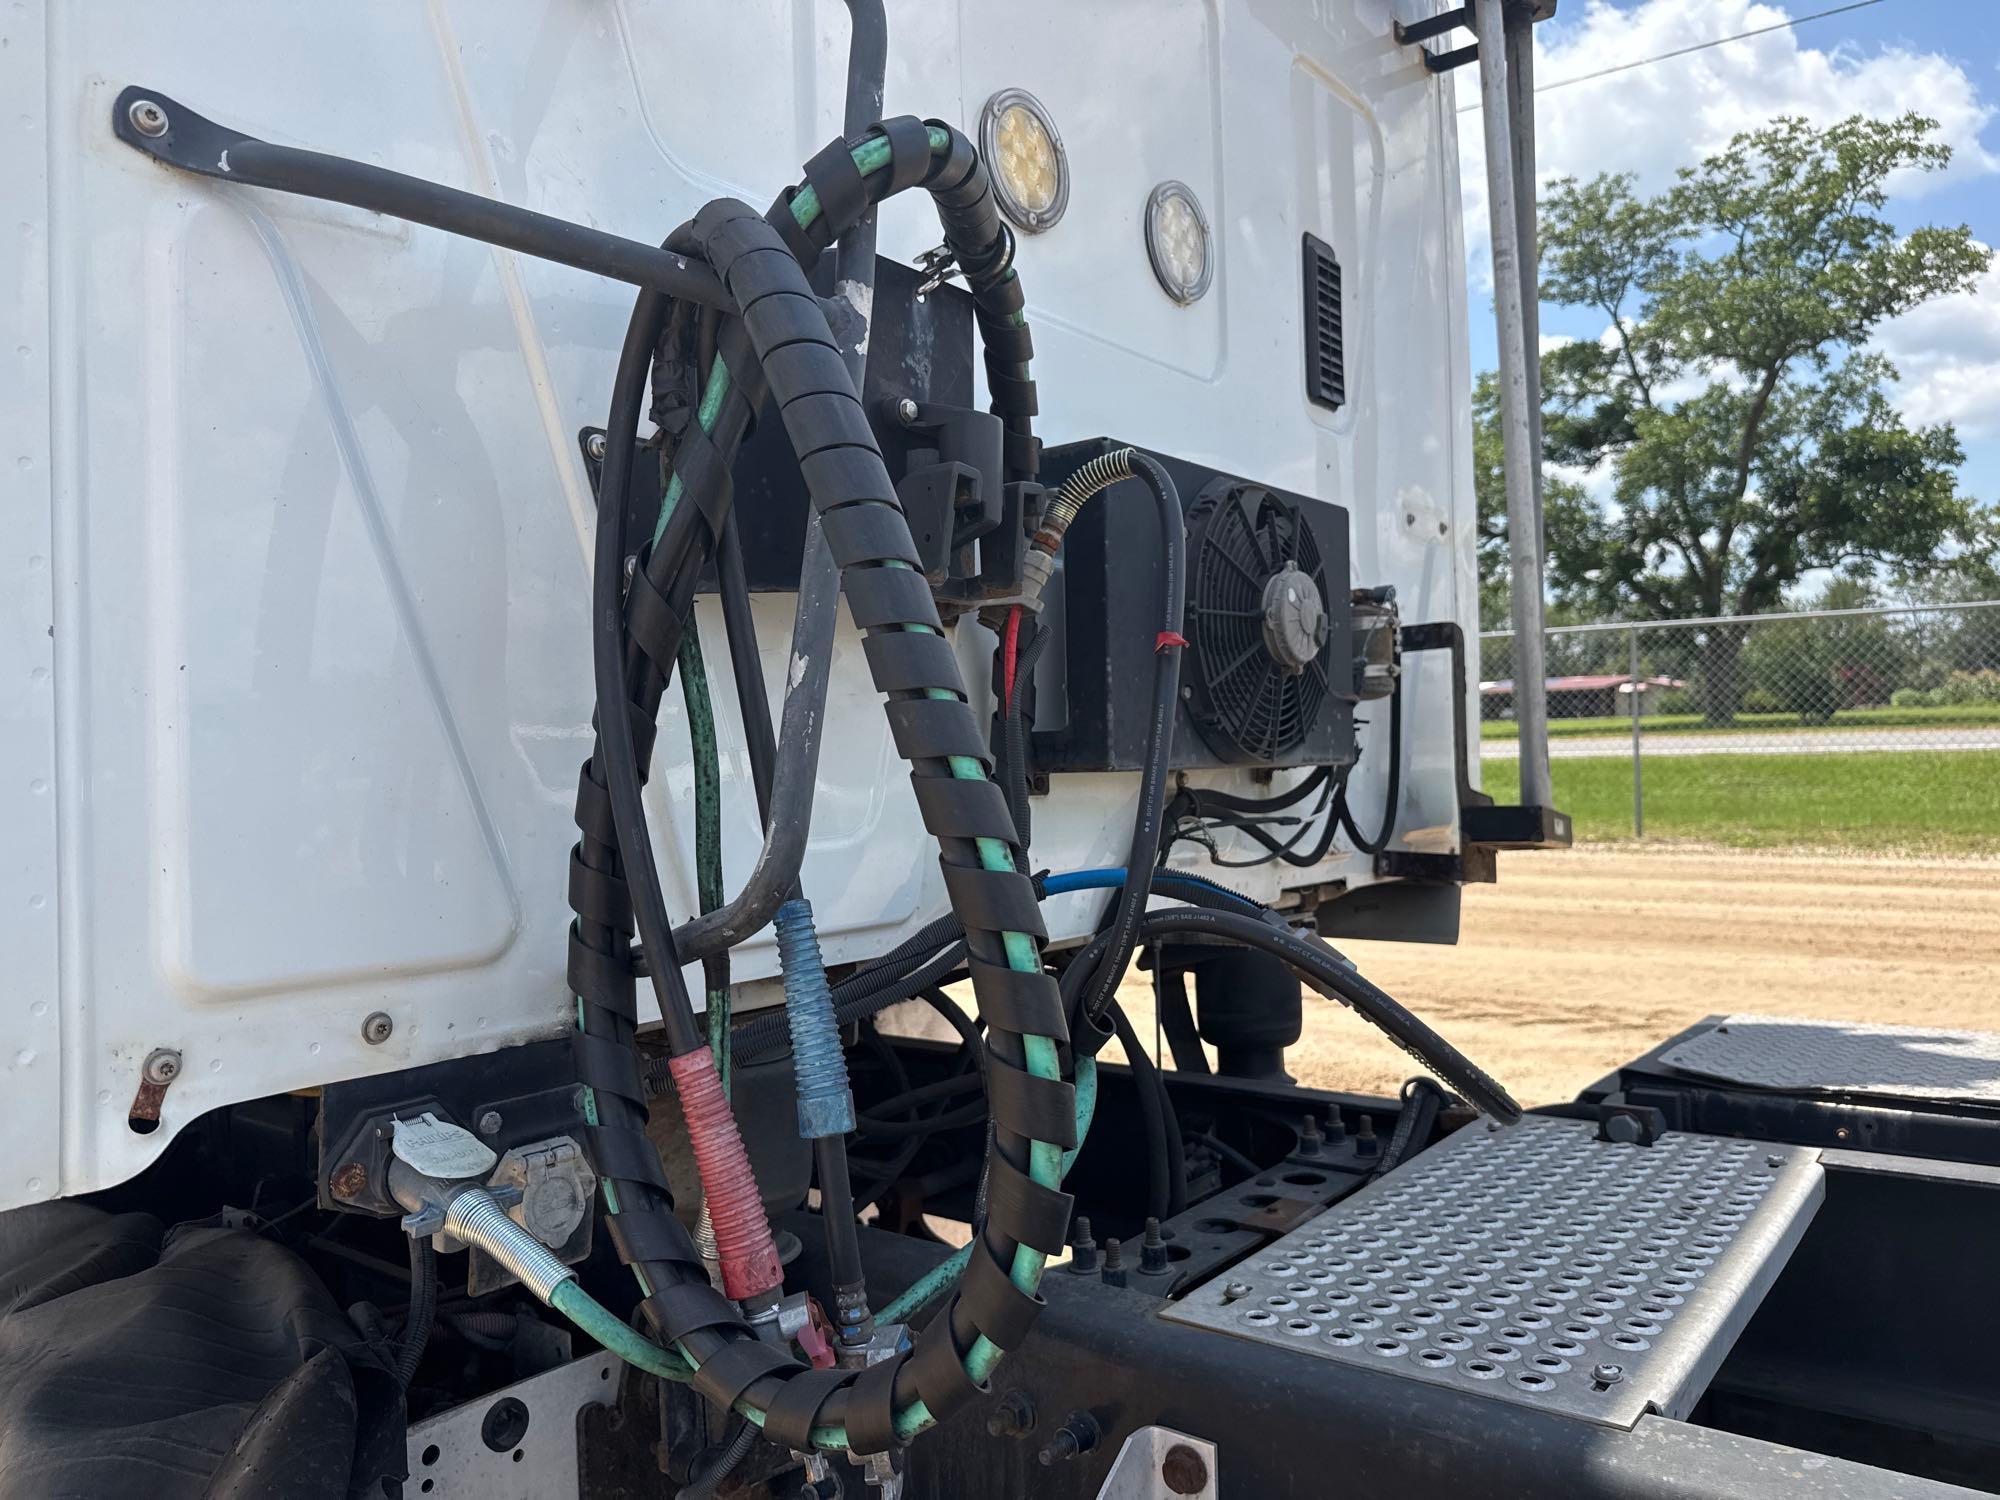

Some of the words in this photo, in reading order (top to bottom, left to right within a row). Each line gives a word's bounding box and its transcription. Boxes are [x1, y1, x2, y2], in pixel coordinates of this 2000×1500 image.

[1093, 1001, 1101, 1011] DOT
[1102, 983, 1110, 993] AIR
[1106, 964, 1119, 984] BRAKE
